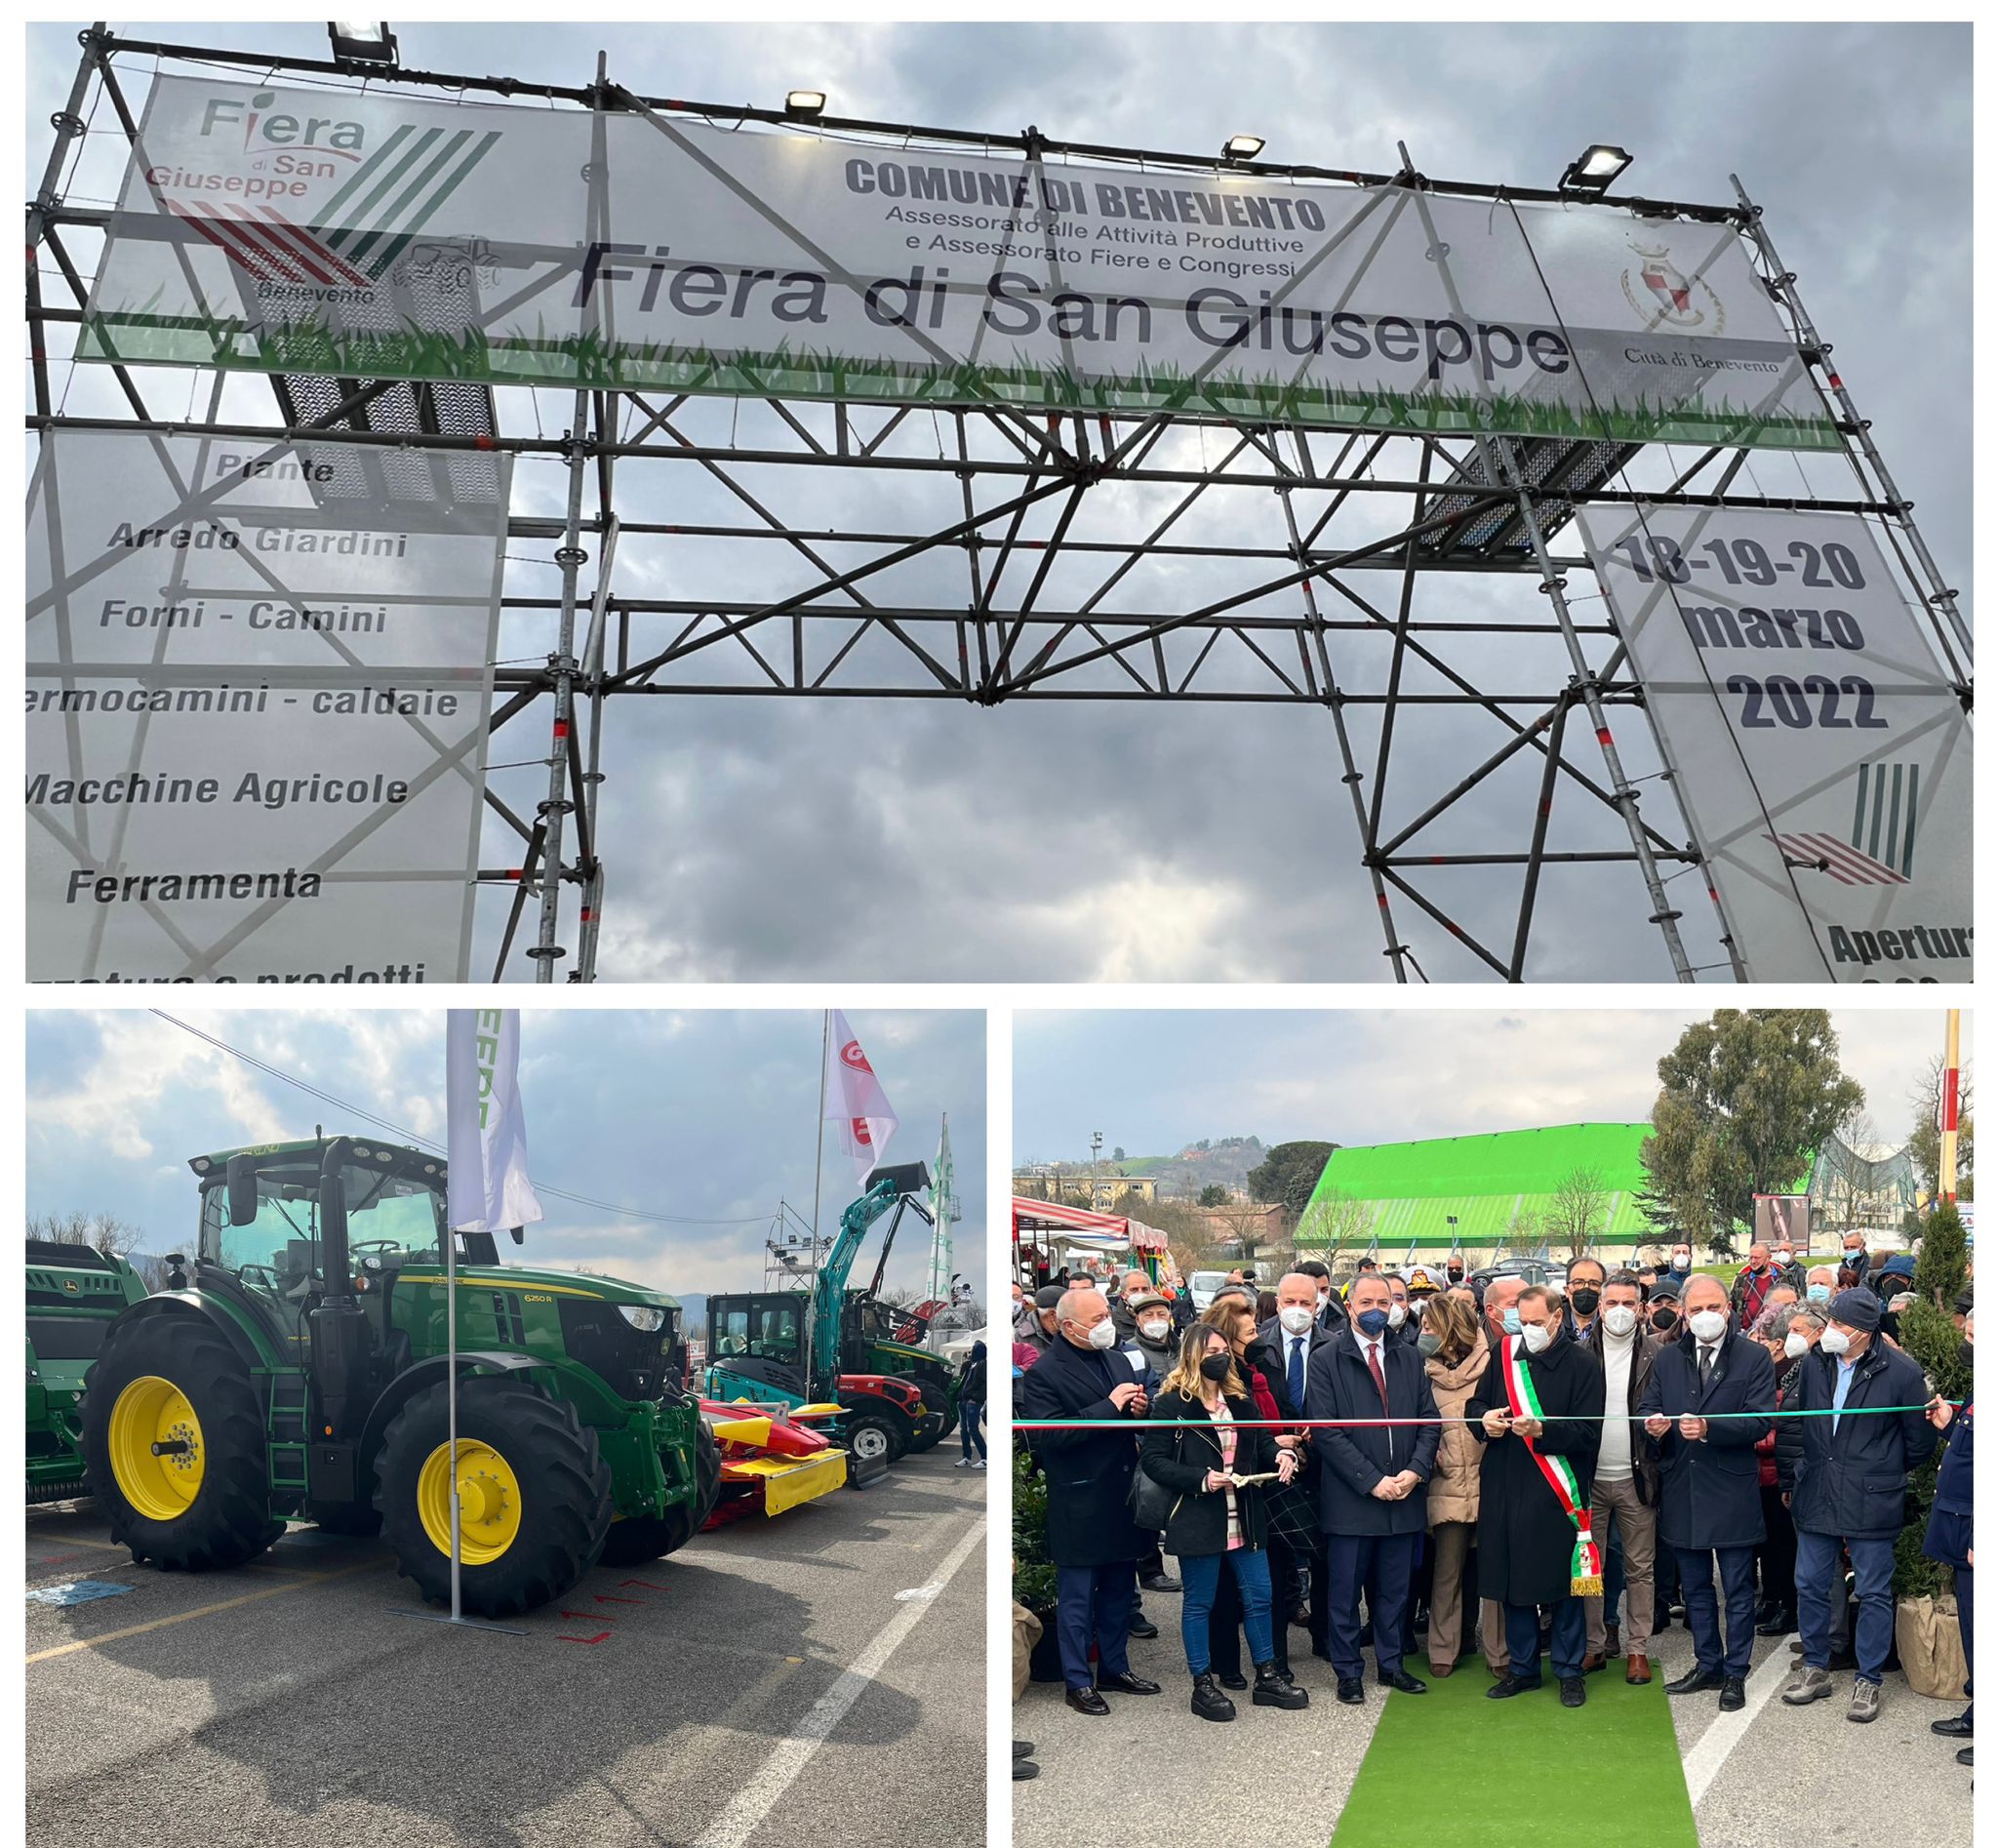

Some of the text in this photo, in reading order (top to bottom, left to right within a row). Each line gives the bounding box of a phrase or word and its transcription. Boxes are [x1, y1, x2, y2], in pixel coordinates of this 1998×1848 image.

[200, 92, 365, 153] Fiera
[144, 165, 308, 199] Giuseppe
[253, 155, 337, 180] di San
[845, 158, 1327, 232] COMUNE DI BENEVENTO
[885, 205, 1304, 254] Assessorato alle Attività Produttive
[905, 235, 1297, 279] e Assessorato Fiere e Congressi
[257, 280, 376, 304] Benevento
[569, 241, 1571, 382] Fiera di San Giuseppe
[1624, 347, 1778, 375] Città di Benevento
[216, 454, 335, 483] Piante
[106, 522, 408, 558] Arredo Giardini
[1616, 535, 1866, 590] 18-19-20
[100, 598, 206, 629] Forni
[248, 601, 387, 633] Camini
[1682, 606, 1865, 651] marzo
[25, 684, 269, 713] ermocamini
[312, 687, 459, 717] caldaie
[1726, 674, 1890, 730] 2022
[25, 772, 409, 809] Macchine Agricole
[66, 867, 323, 904] Ferramenta
[1827, 925, 1974, 966] Apertur
